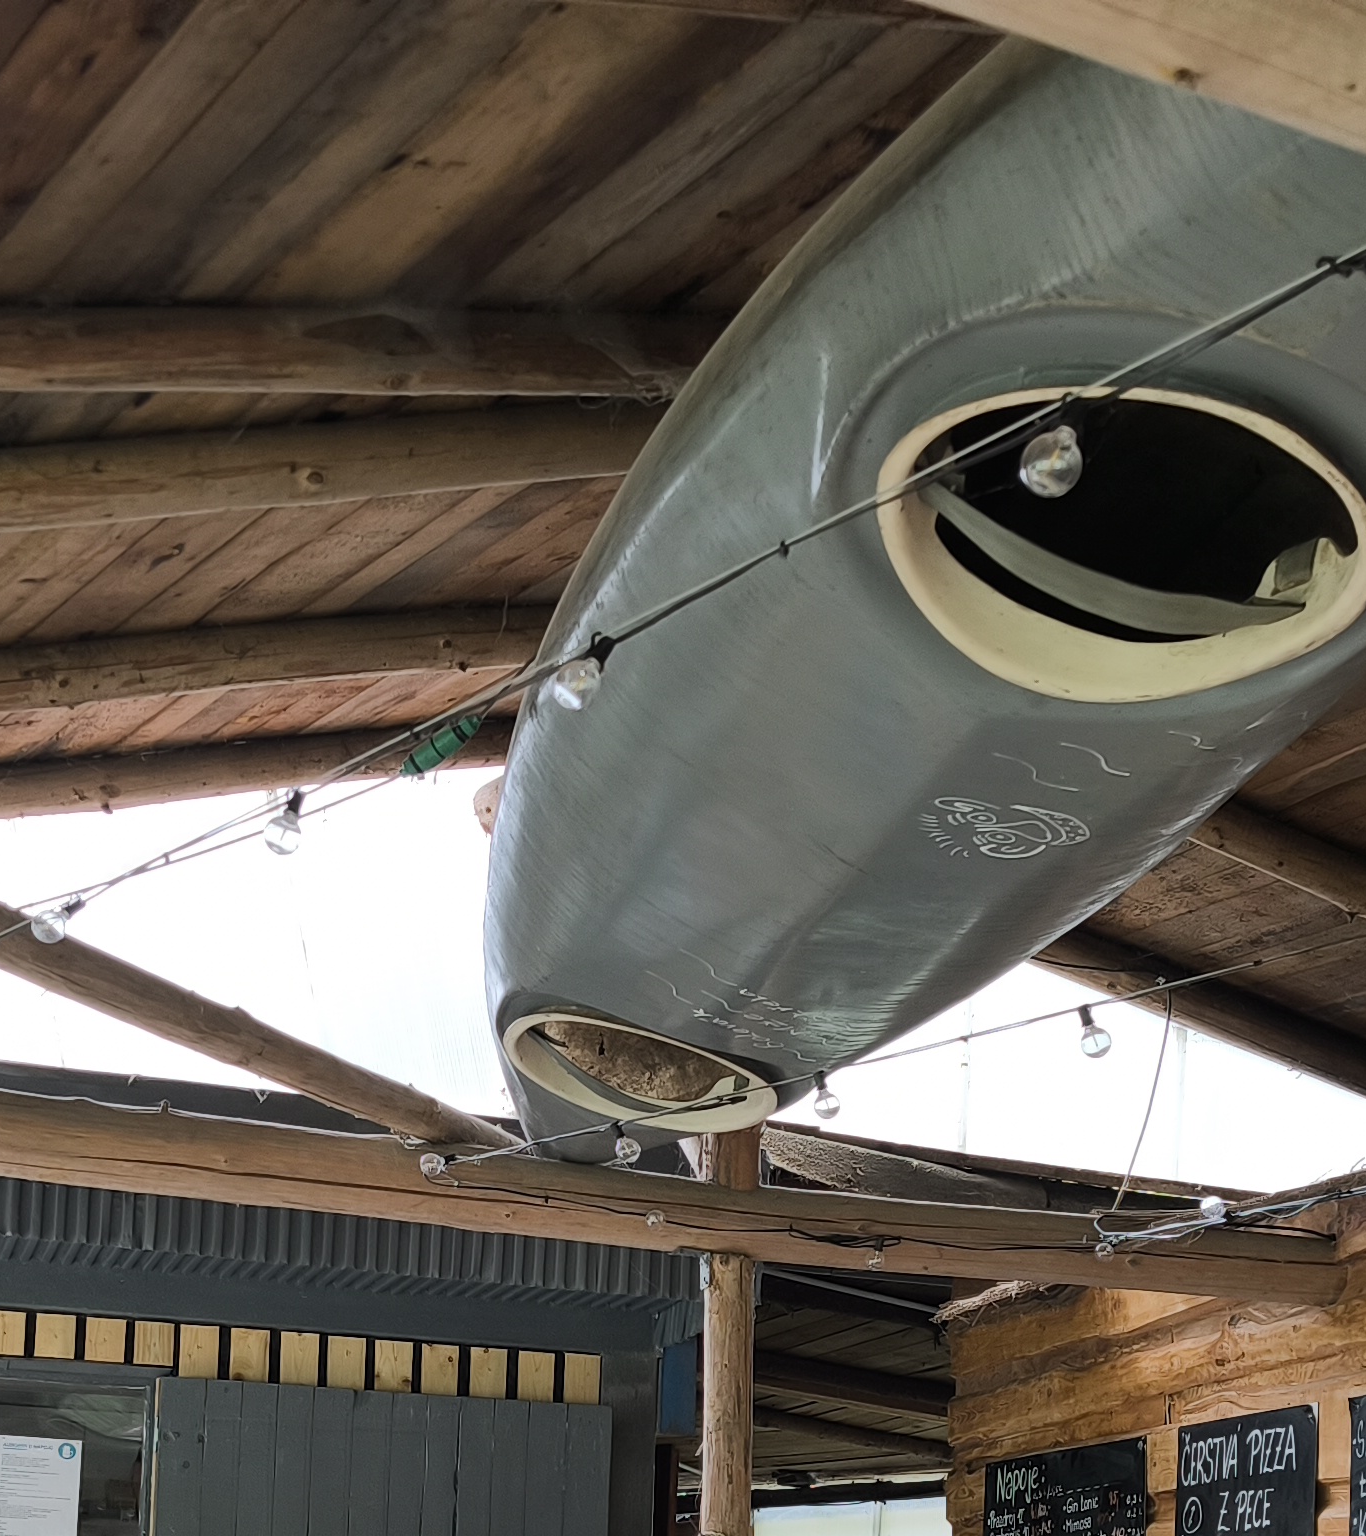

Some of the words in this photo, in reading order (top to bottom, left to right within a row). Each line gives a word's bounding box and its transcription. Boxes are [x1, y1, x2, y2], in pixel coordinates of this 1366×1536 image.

[1181, 1424, 1241, 1486] ČERSTVÁ
[1246, 1425, 1296, 1476] PIZZA
[1066, 1517, 1091, 1533] Mimosa
[1217, 1491, 1230, 1531] Z
[1235, 1488, 1274, 1531] PECE
